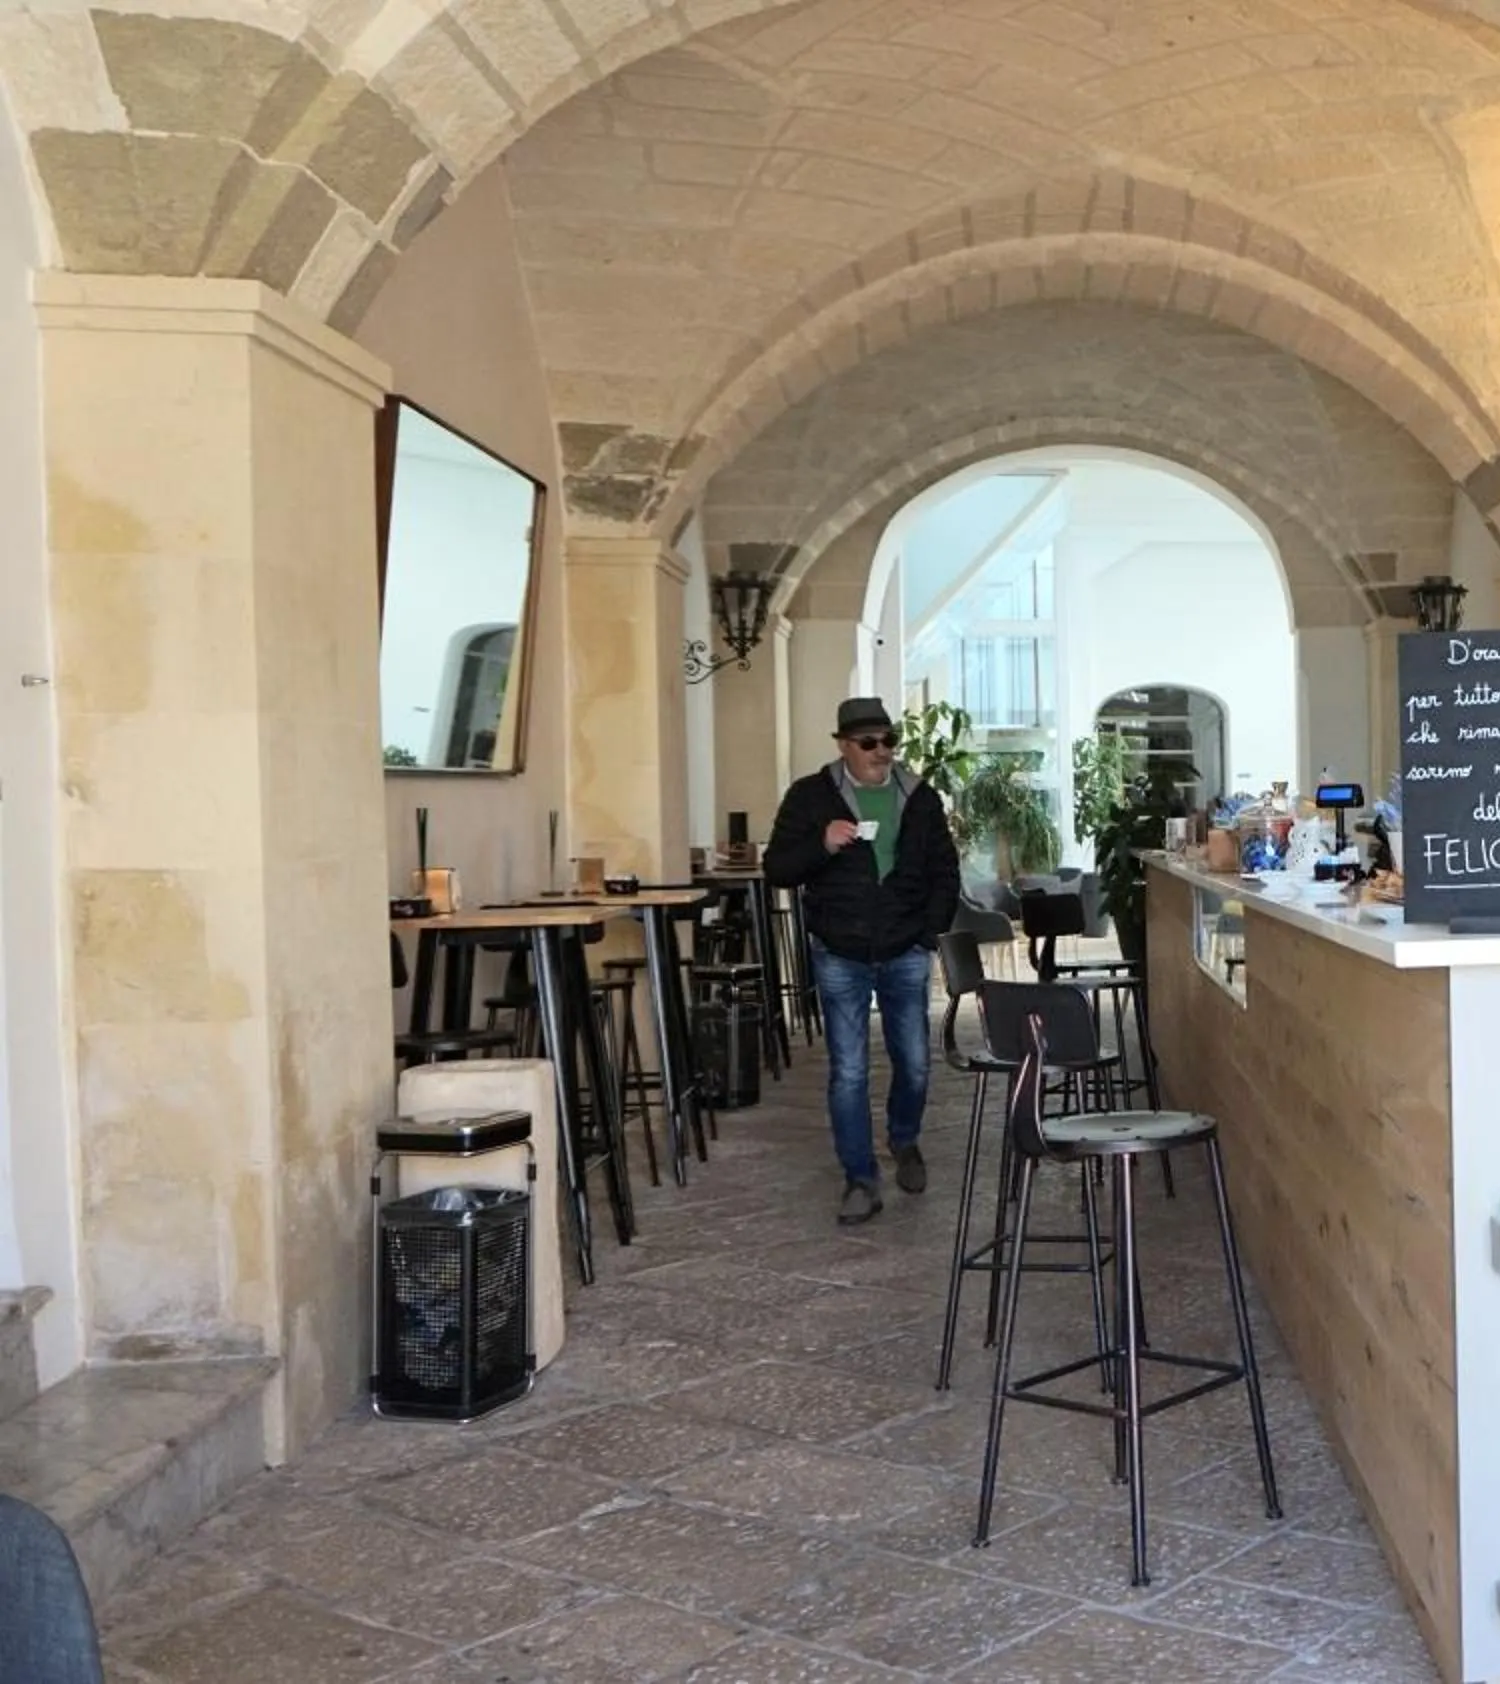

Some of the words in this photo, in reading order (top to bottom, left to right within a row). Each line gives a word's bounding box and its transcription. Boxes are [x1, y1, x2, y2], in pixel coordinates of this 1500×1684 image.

[1405, 693, 1442, 723] per
[1405, 720, 1441, 744] che
[1405, 763, 1473, 781] saremo
